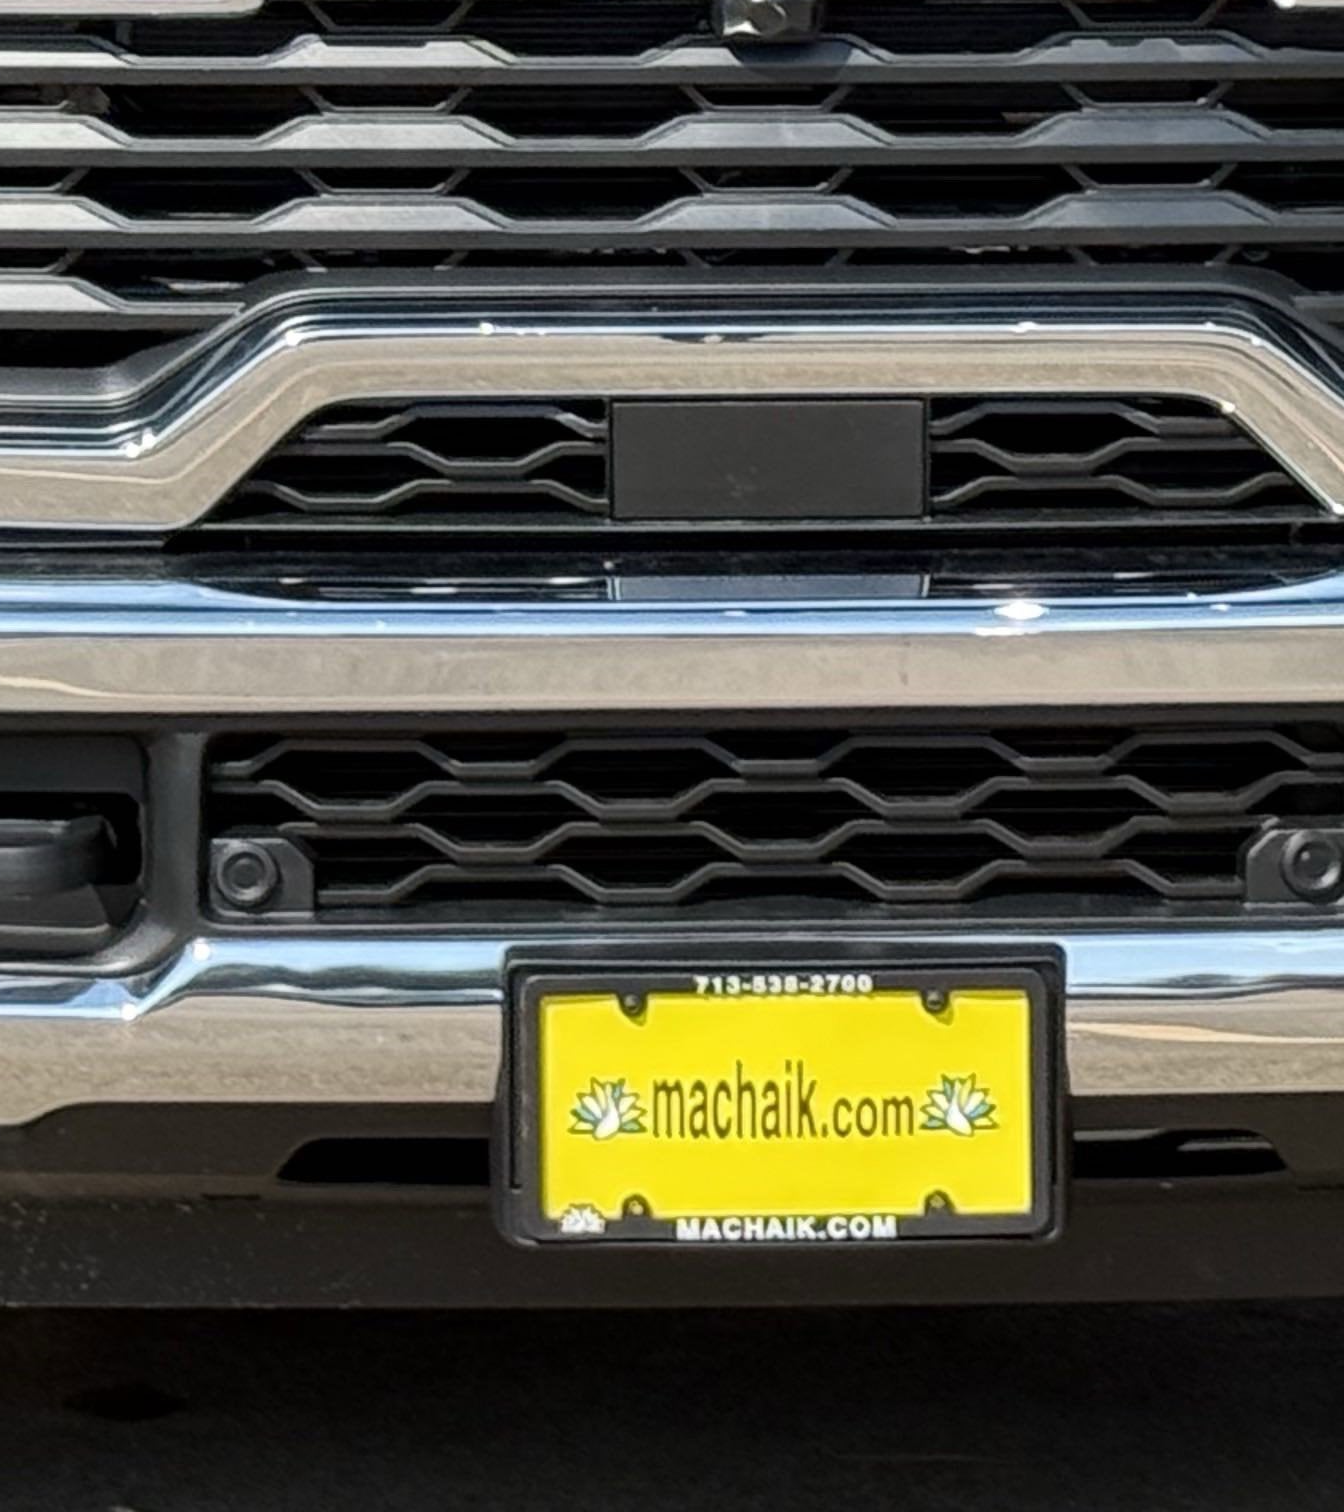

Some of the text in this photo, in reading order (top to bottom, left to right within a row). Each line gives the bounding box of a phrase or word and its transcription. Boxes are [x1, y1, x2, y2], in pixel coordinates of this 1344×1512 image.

[692, 974, 875, 995] 713-538-2700
[652, 1060, 916, 1140] machaik.com
[676, 1216, 897, 1240] MACHAIK.COM
